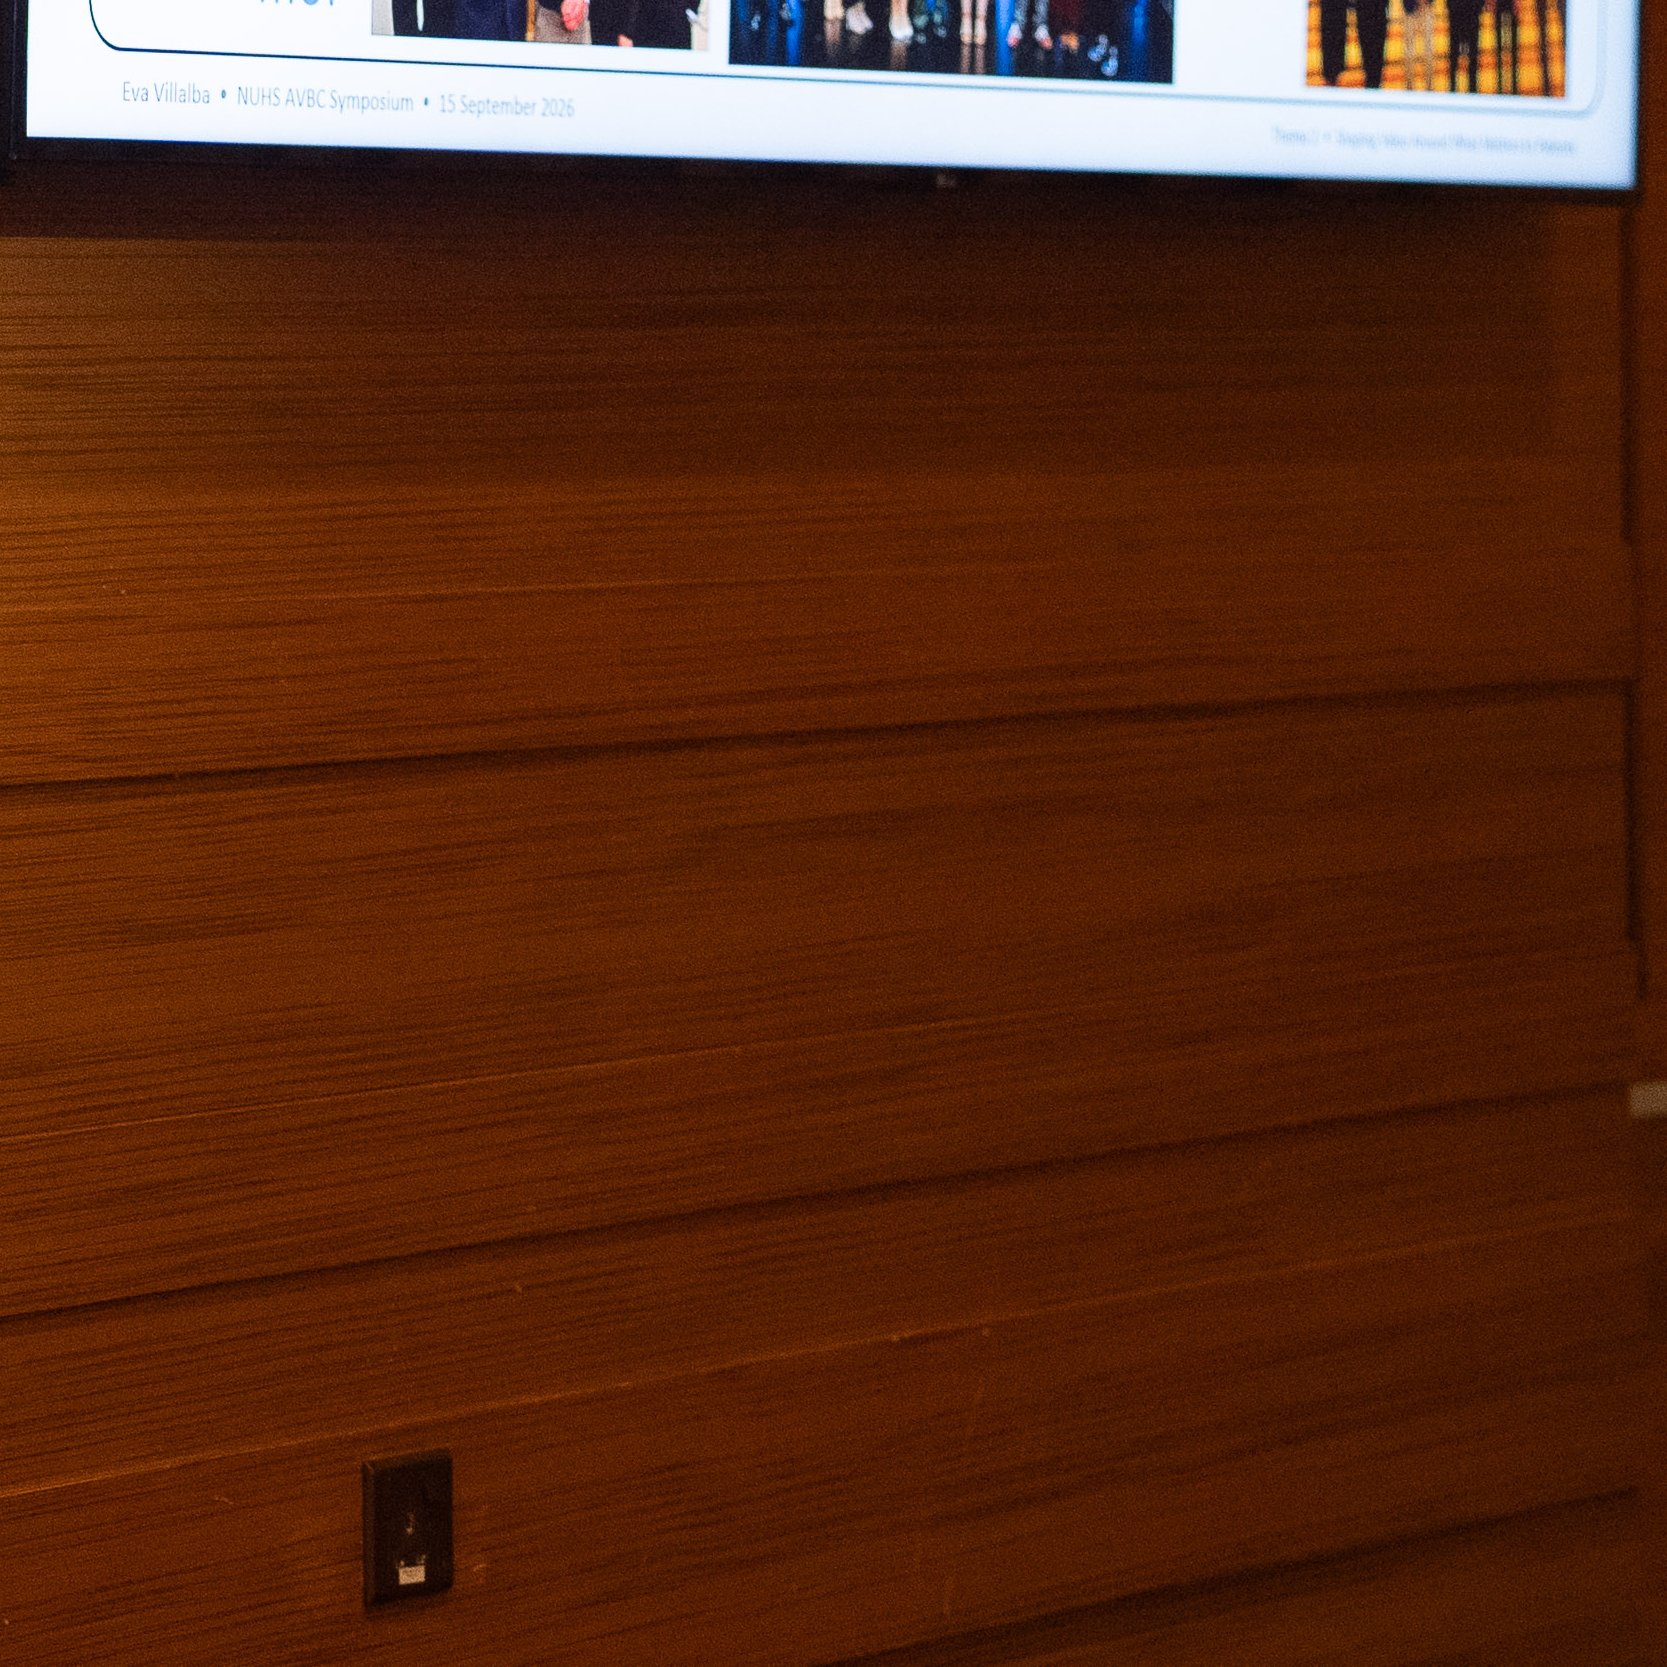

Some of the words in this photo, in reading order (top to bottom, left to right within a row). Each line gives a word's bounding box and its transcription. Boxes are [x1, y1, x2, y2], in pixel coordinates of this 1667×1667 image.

[120, 81, 149, 103] Eva
[152, 81, 211, 106] Villalba
[236, 85, 281, 109] NUHS
[283, 87, 327, 109] AVBC
[329, 89, 415, 116] Symposium
[439, 93, 457, 114] 15
[459, 94, 537, 120] September
[540, 97, 576, 118] 2026
